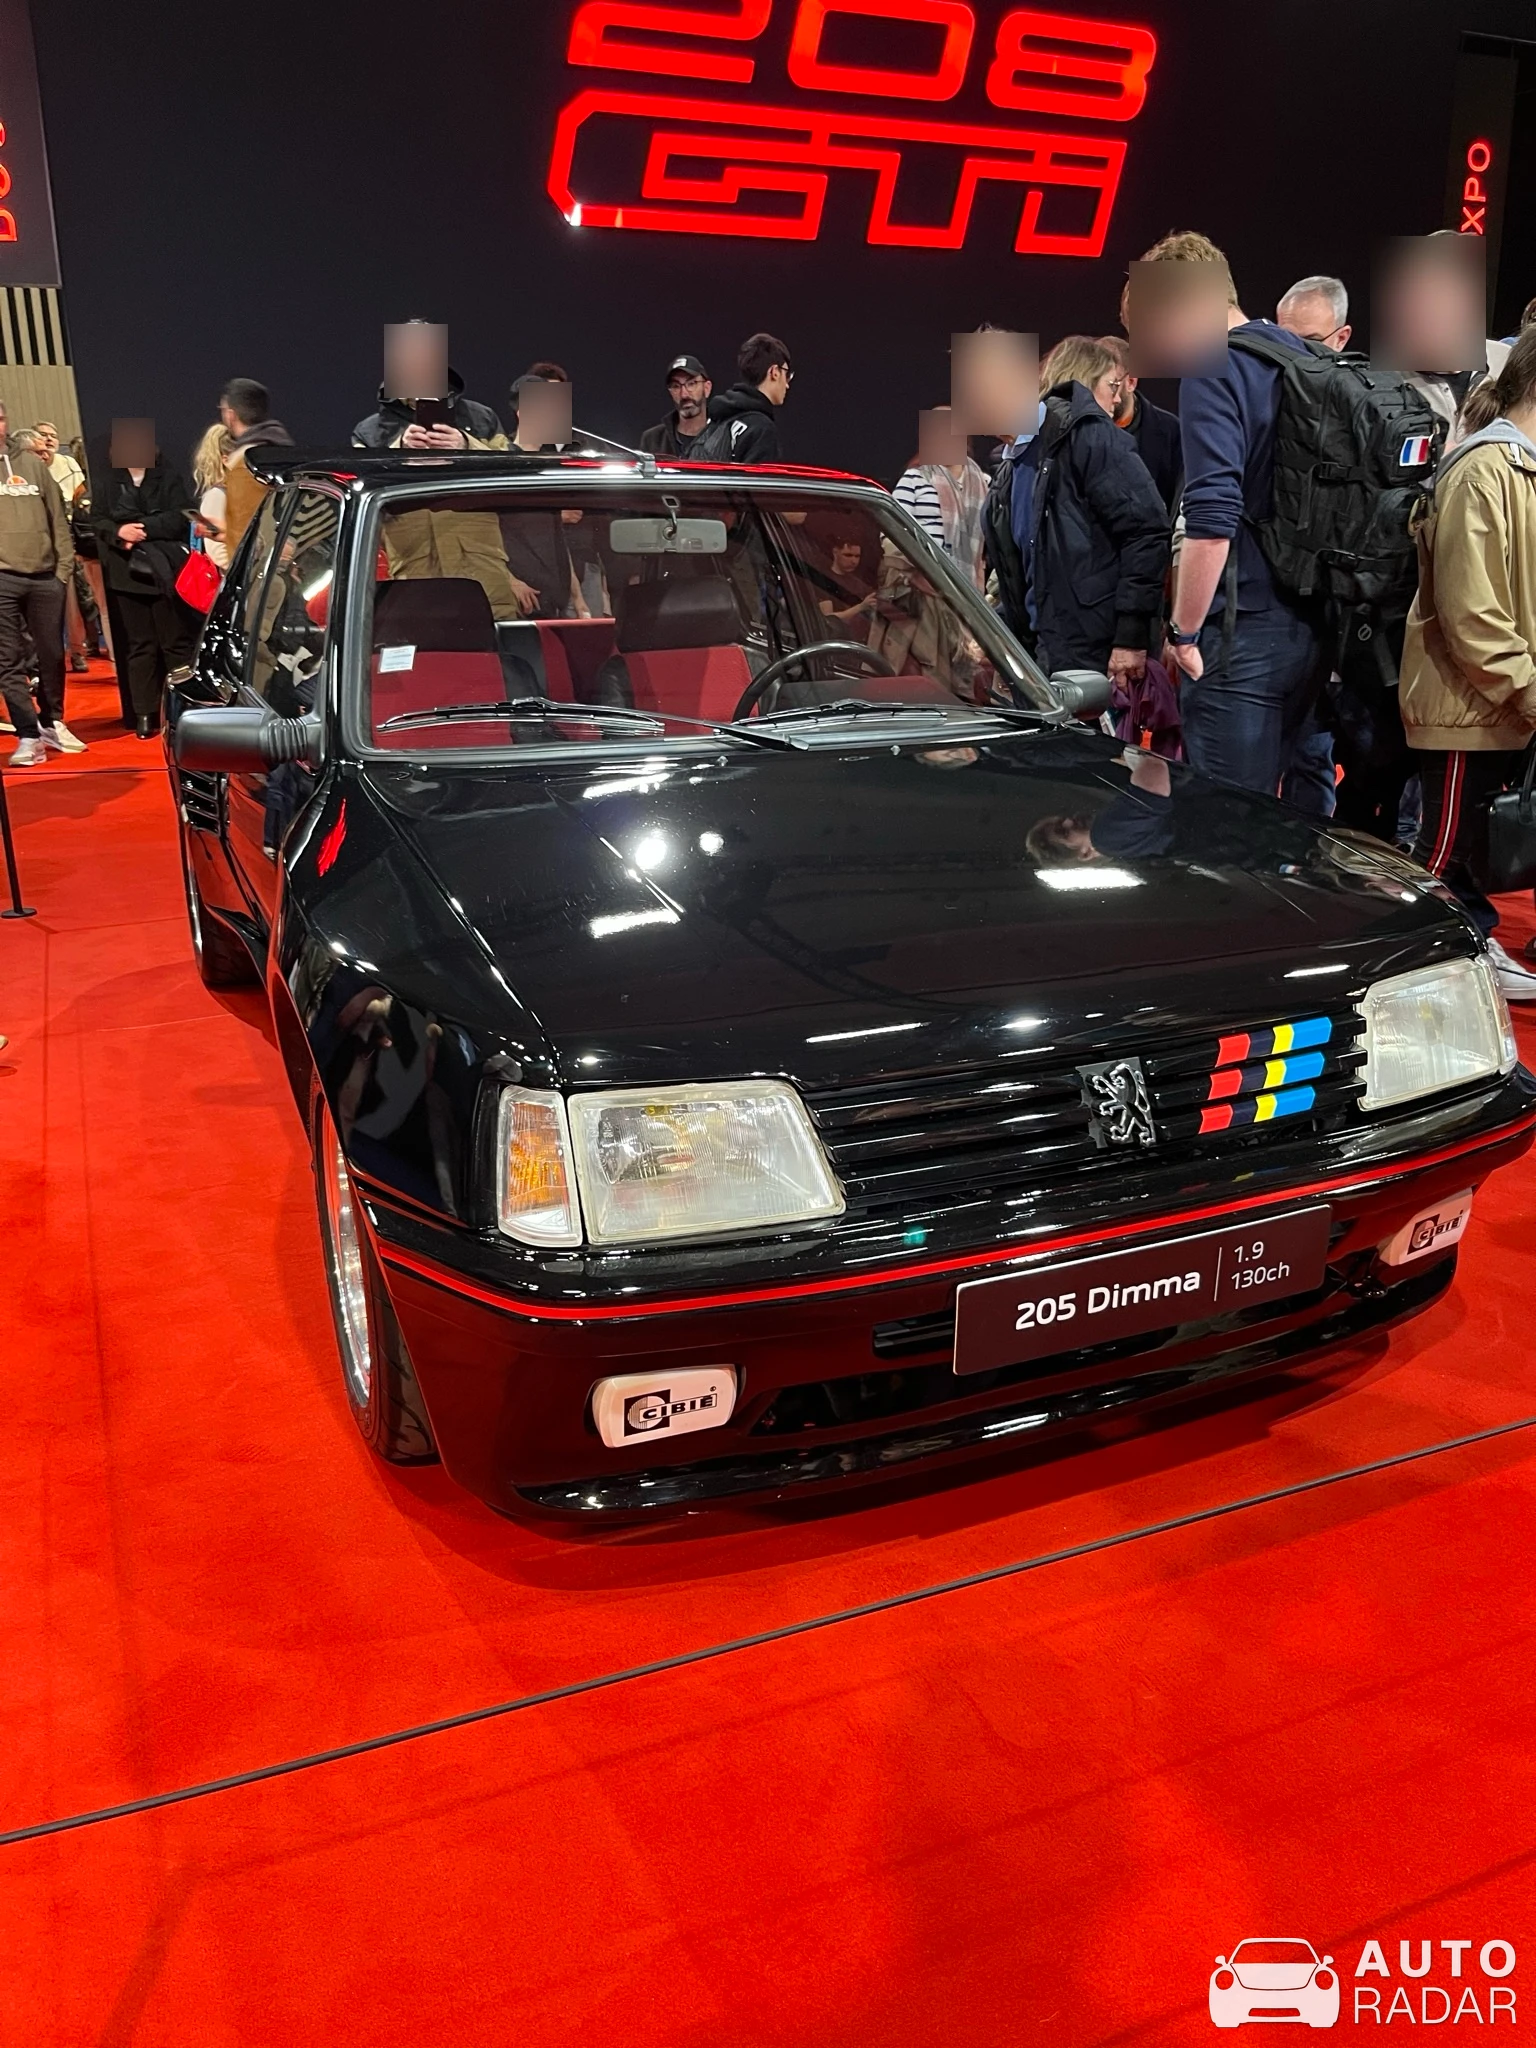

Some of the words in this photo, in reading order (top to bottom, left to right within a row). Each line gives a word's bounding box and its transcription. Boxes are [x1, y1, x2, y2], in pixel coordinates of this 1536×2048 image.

[567, 0, 1156, 121] 208
[1461, 143, 1490, 235] XPO
[1230, 1261, 1291, 1291] 130ch
[1233, 1241, 1265, 1264] 1.9
[1015, 1292, 1077, 1331] 205
[1087, 1271, 1201, 1314] Dimma
